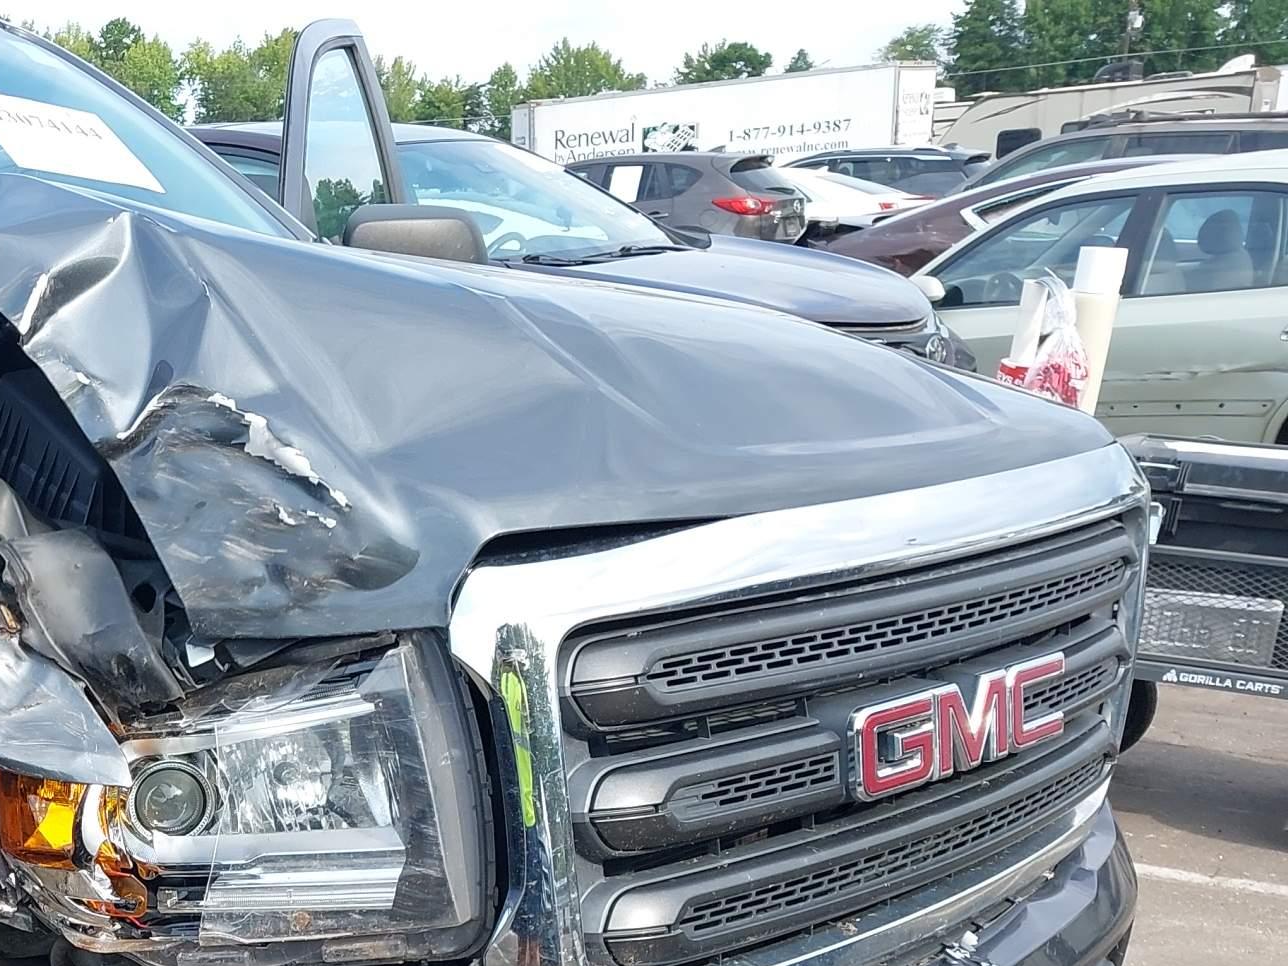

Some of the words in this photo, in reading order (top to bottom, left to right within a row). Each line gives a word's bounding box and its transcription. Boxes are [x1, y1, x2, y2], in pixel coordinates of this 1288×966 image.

[554, 122, 635, 150] Renewal
[729, 118, 852, 142] 1-877-914-9387
[1179, 672, 1233, 689] GORILLA
[1235, 680, 1281, 694] CARTS
[848, 651, 1065, 802] GMC
